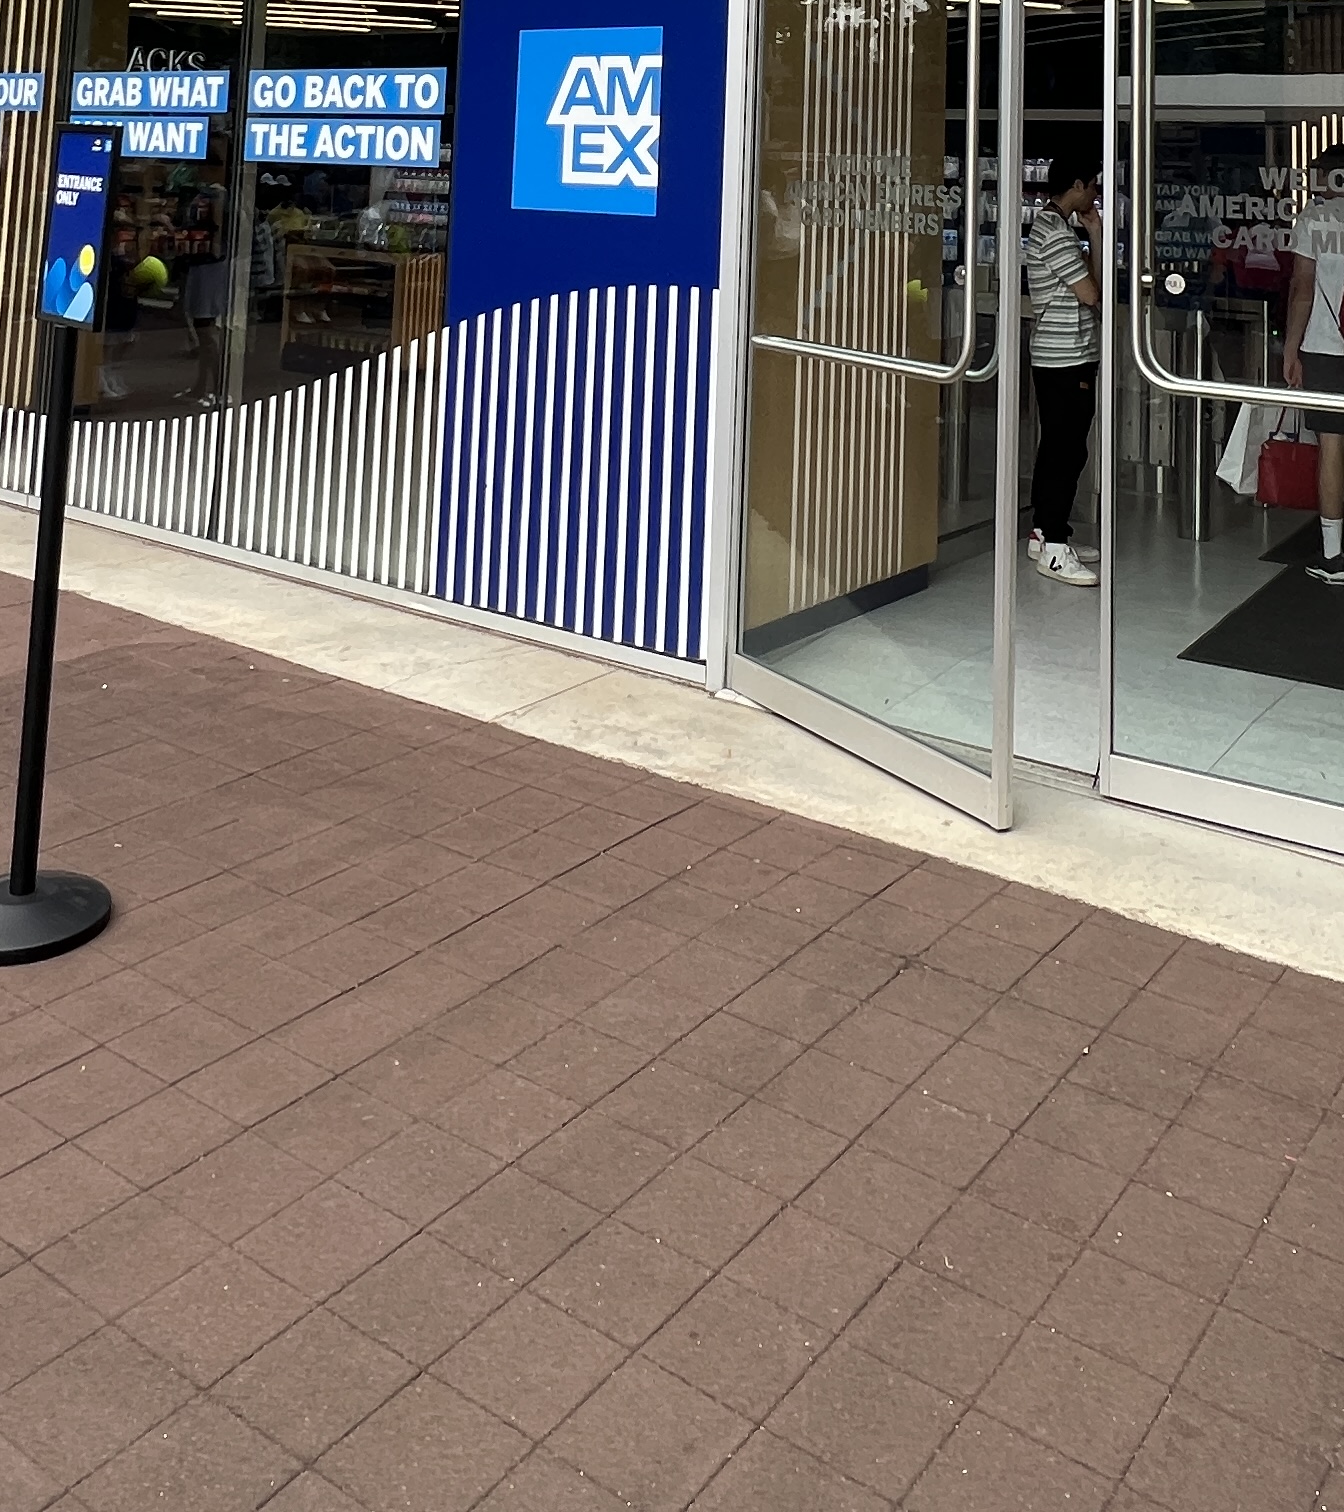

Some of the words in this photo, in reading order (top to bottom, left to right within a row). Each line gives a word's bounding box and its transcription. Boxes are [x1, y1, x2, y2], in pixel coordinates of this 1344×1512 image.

[77, 77, 142, 107] GRAB
[149, 77, 224, 108] WHAT
[254, 75, 296, 108] GO
[304, 74, 387, 109] BACK
[394, 74, 439, 109] TO
[128, 121, 203, 153] WANT
[251, 123, 308, 157] THE
[314, 124, 434, 161] ACTION
[827, 155, 911, 178] WELCOME
[58, 174, 103, 192] ENTRANCE
[876, 184, 962, 208] EXPRESS
[56, 190, 79, 206] ONLY
[850, 209, 939, 235] MEMBERS
[1212, 224, 1298, 252] CARD
